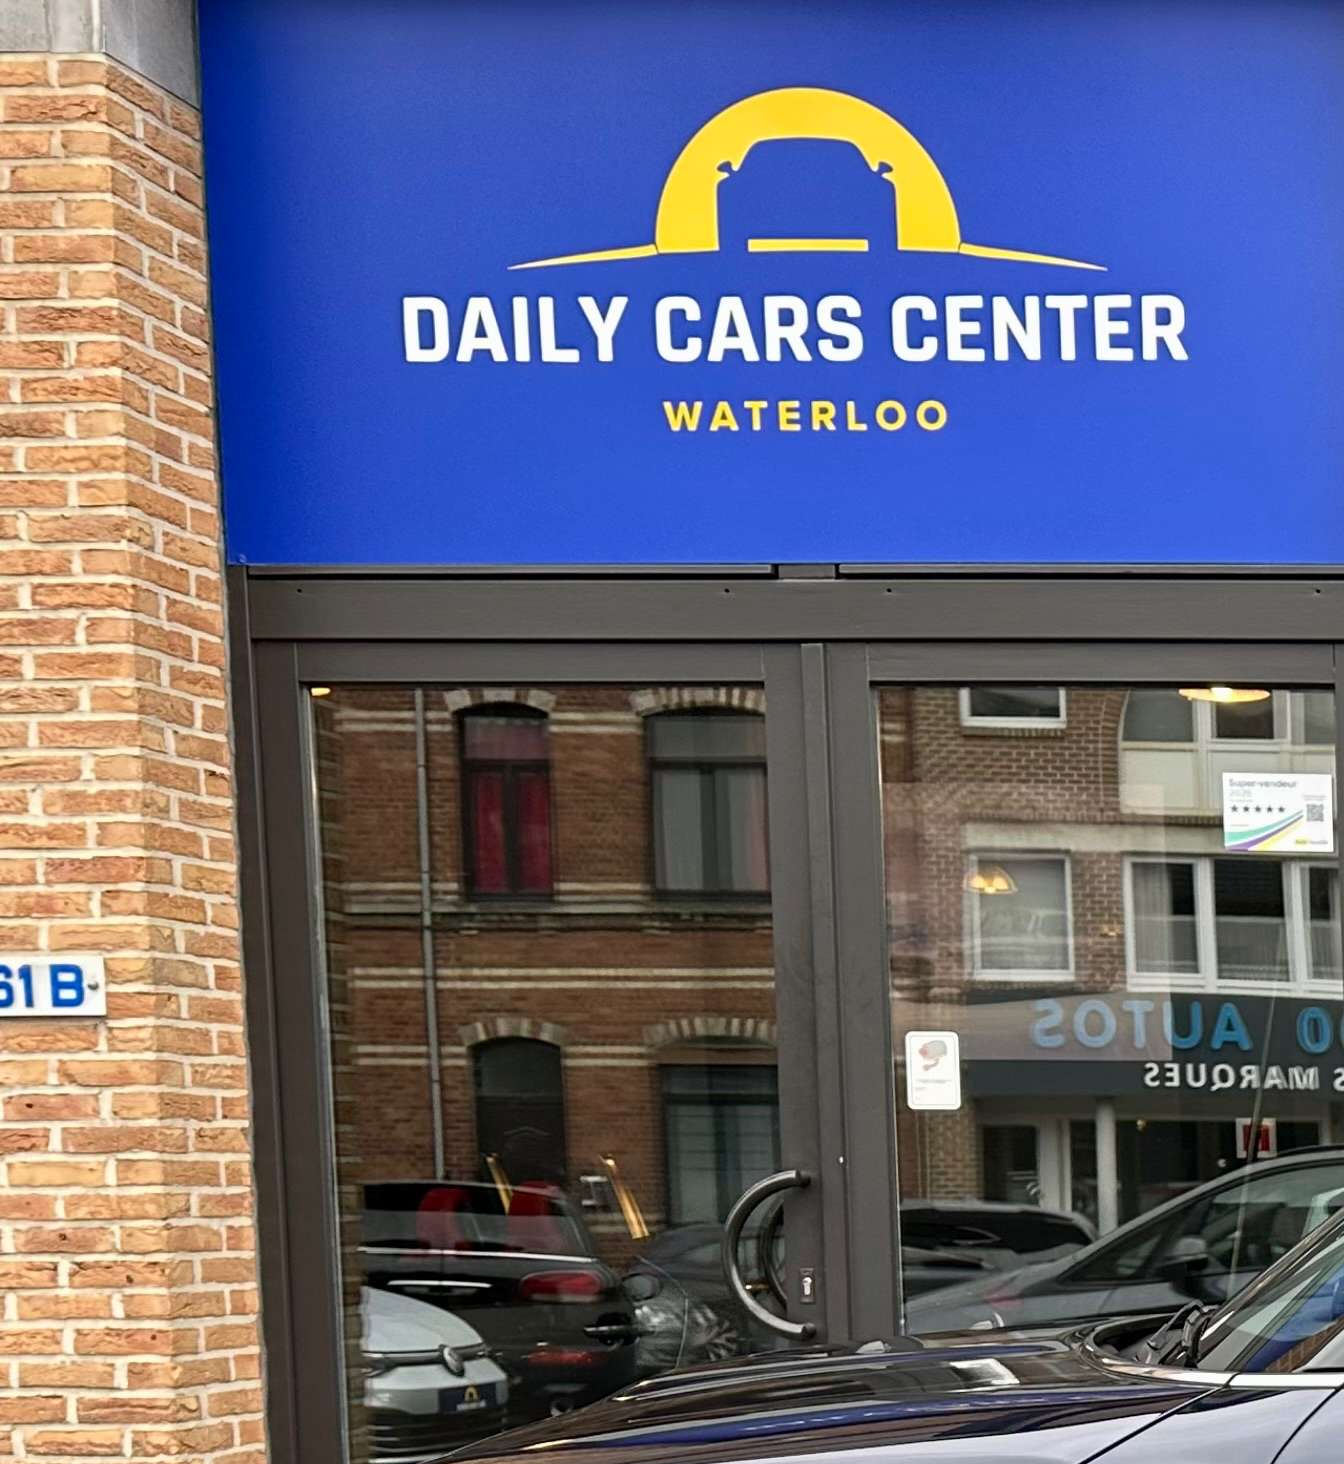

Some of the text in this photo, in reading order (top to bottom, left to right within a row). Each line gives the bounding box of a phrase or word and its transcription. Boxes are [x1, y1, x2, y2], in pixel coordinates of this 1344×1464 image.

[402, 294, 1189, 363] DAILY CARS CENTER
[662, 400, 948, 432] WATERLOO
[49, 964, 85, 1008] B
